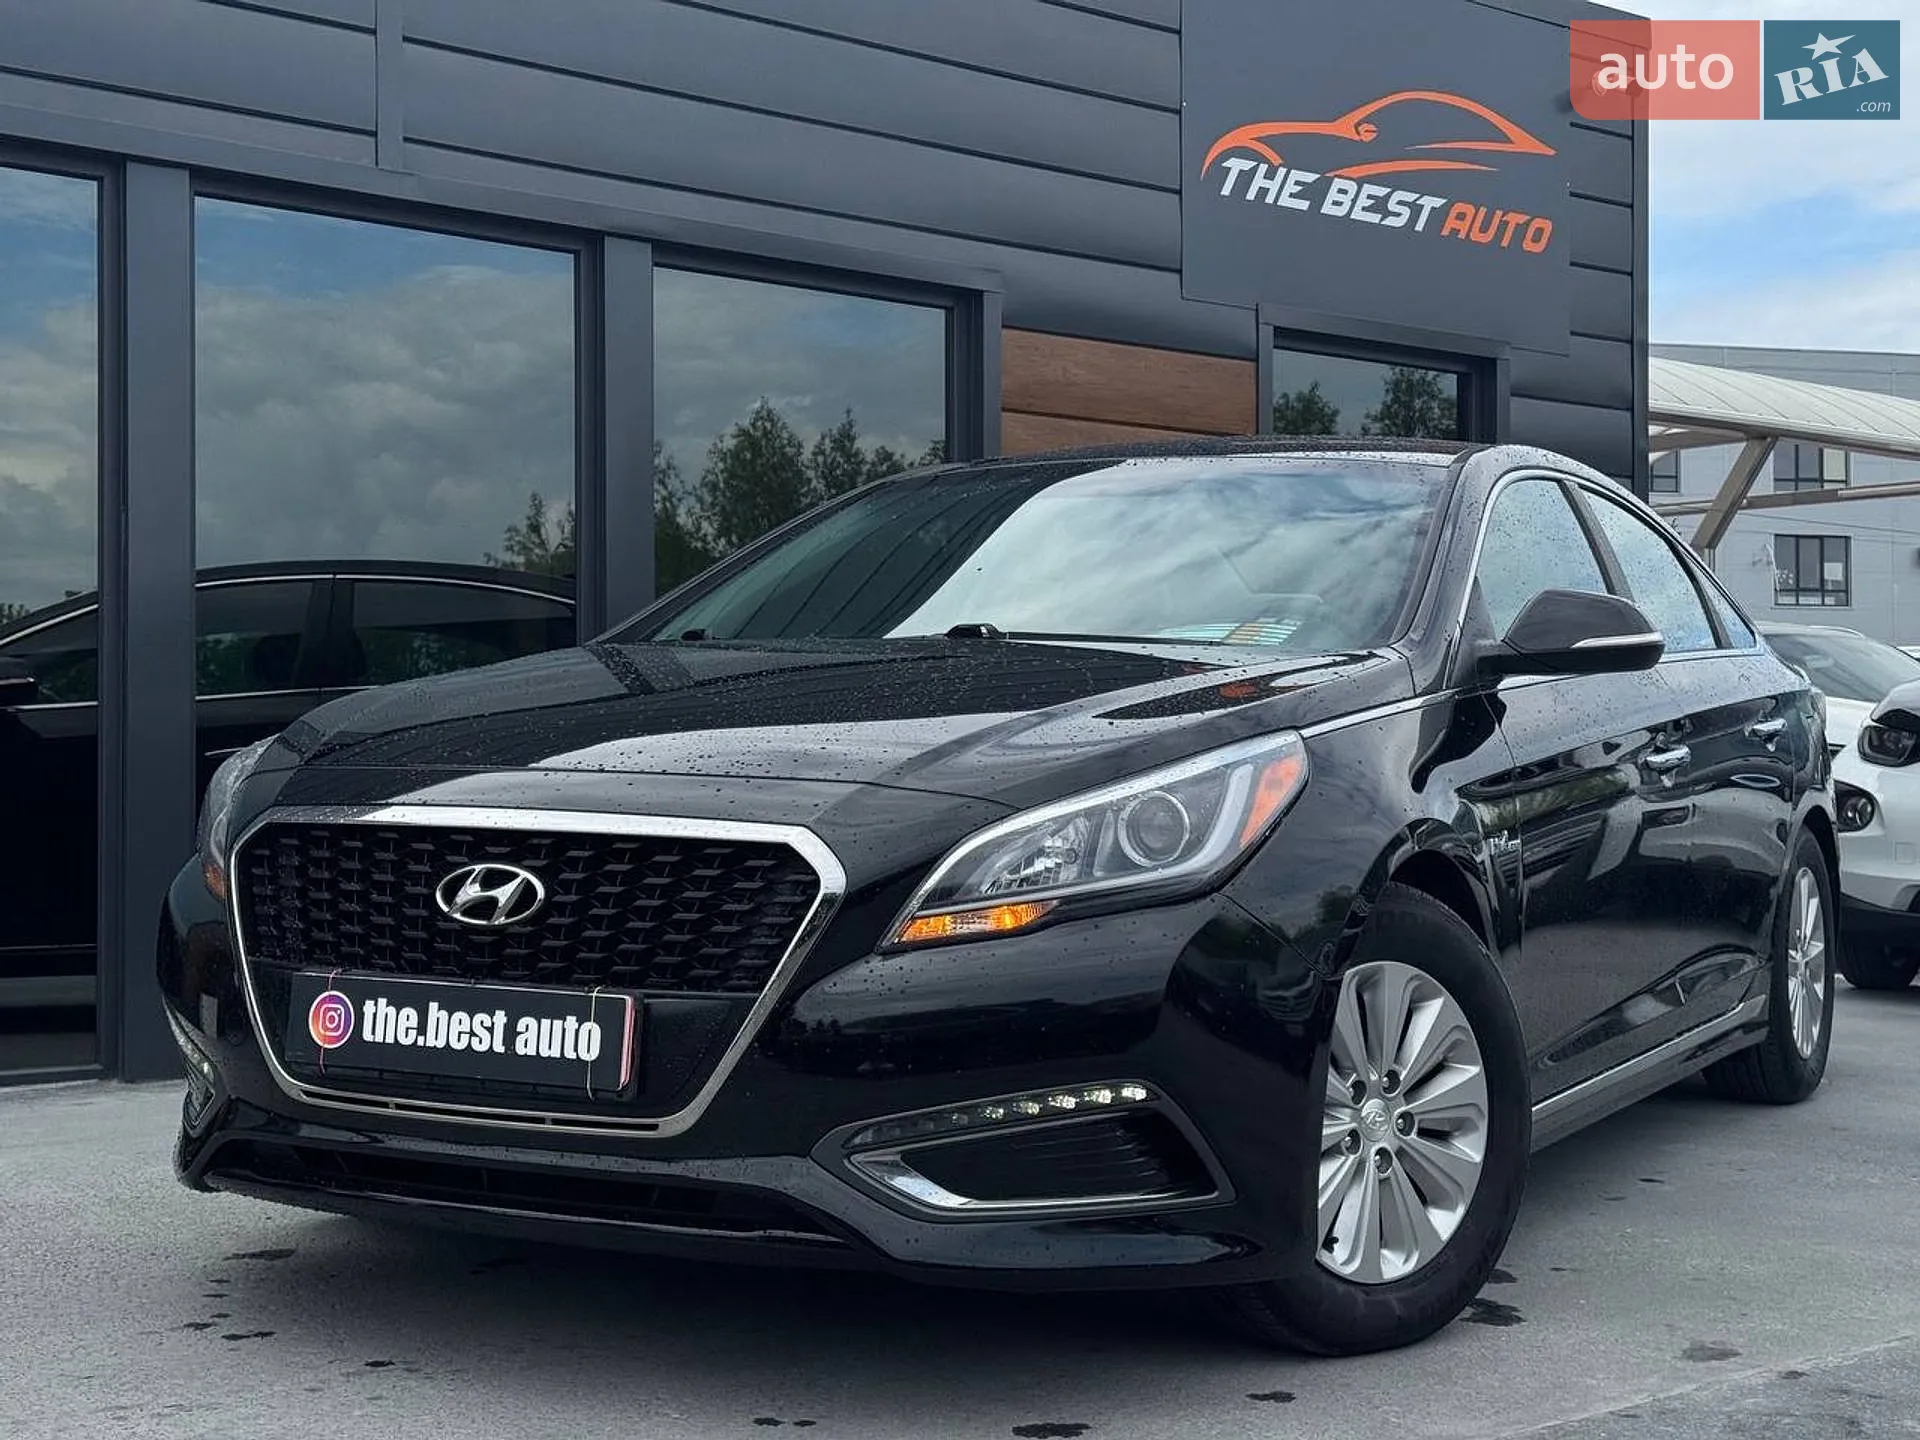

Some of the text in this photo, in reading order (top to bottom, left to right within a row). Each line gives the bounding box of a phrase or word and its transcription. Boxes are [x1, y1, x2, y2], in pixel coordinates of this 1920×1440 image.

[1220, 157, 1553, 254] THE BEST AUTO
[362, 997, 602, 1061] the.best auto
